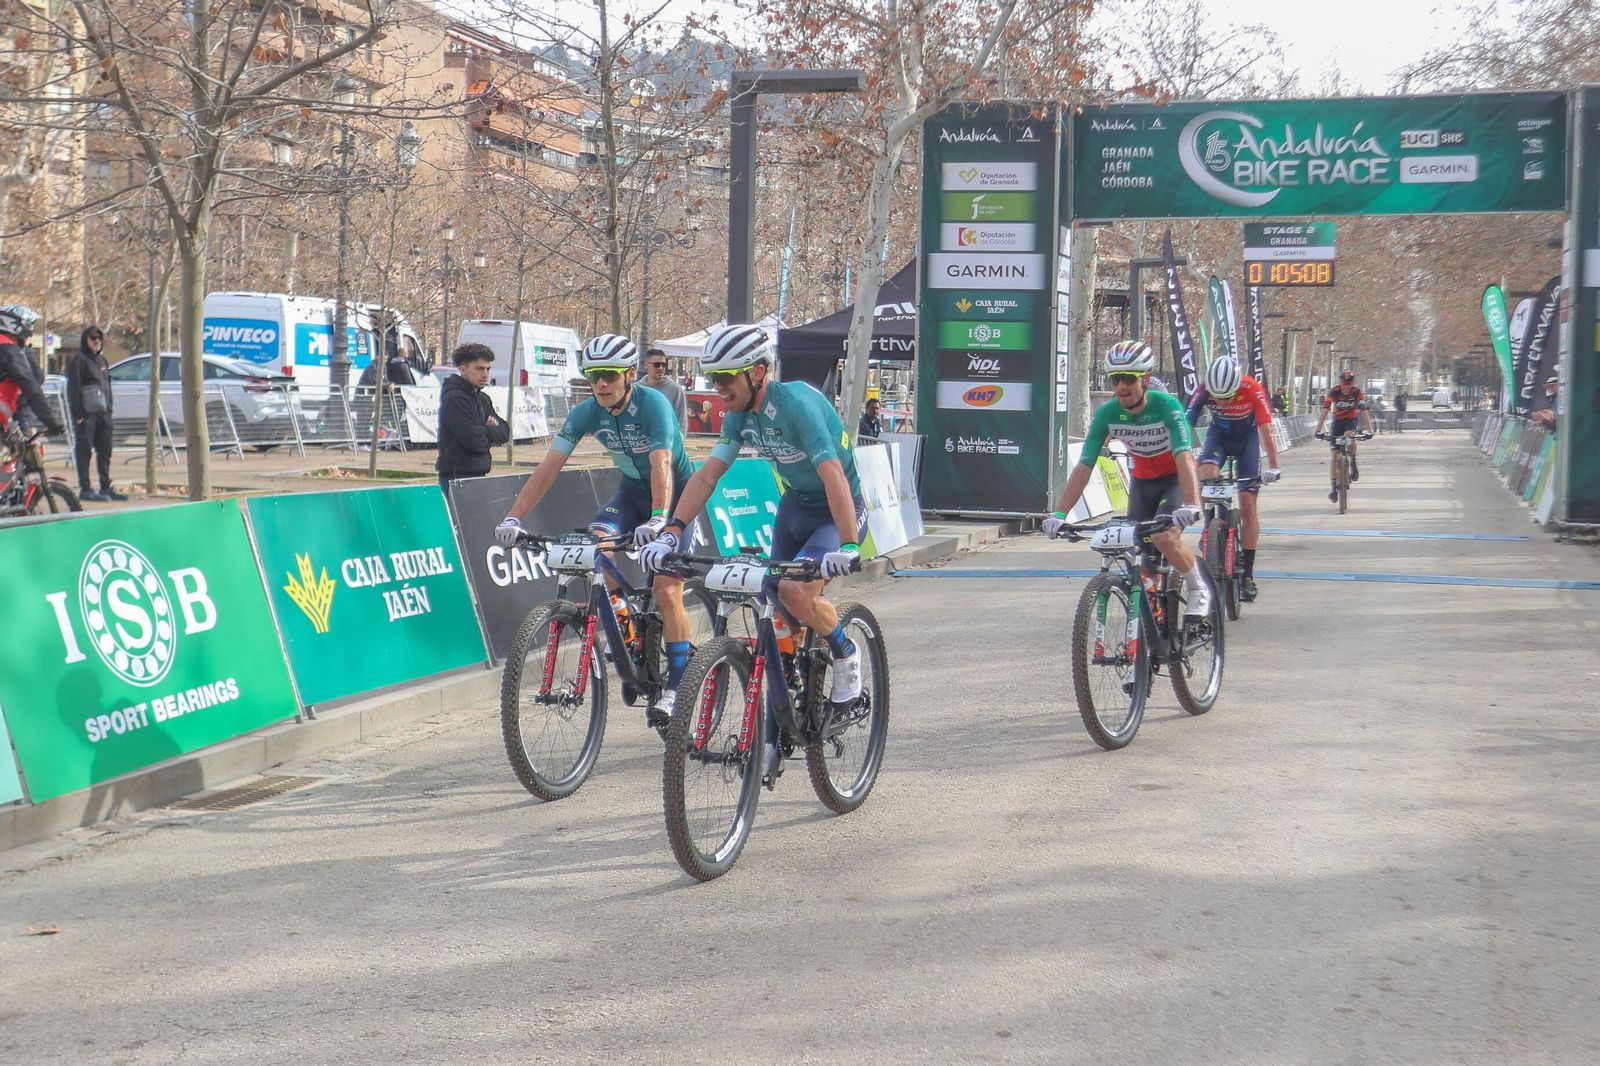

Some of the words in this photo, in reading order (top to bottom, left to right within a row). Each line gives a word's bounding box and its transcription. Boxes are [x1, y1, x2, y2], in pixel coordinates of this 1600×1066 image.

[939, 127, 1001, 143] Andalucía
[1232, 120, 1389, 161] Andalucía
[1407, 132, 1435, 145] UCI
[1101, 147, 1154, 159] GRANADA
[1101, 160, 1131, 174] JAÉN
[1233, 159, 1299, 187] BIKE
[1307, 157, 1392, 186] RACE
[1409, 164, 1469, 176] GARMIN
[1101, 175, 1153, 189] CÓRDOBA
[1263, 226, 1303, 234] STAGE
[1306, 226, 1316, 234] 2
[1270, 237, 1307, 245] GRANADA
[947, 265, 1028, 278] GARMIN
[975, 299, 992, 307] CAJA
[987, 306, 1005, 314] JAÉN
[203, 325, 276, 344] PINVECO
[1167, 268, 1199, 396] GARMIN
[536, 351, 566, 363] enterprise
[967, 359, 1000, 371] NDL
[1112, 427, 1166, 437] TORPADO
[629, 440, 650, 448] RAC
[957, 446, 975, 454] BIKE
[975, 446, 997, 454] RACE
[1101, 527, 1122, 544] 3-1
[561, 547, 584, 565] 7-2
[341, 555, 392, 589] CAJA
[391, 547, 453, 581] RURAL
[721, 564, 749, 587] 7-1
[382, 583, 433, 622] JAÉN
[85, 702, 150, 743] SPORT
[151, 677, 239, 722] BEARINGS
[696, 674, 715, 740] MANITOU
[739, 677, 760, 743] MANITOU
